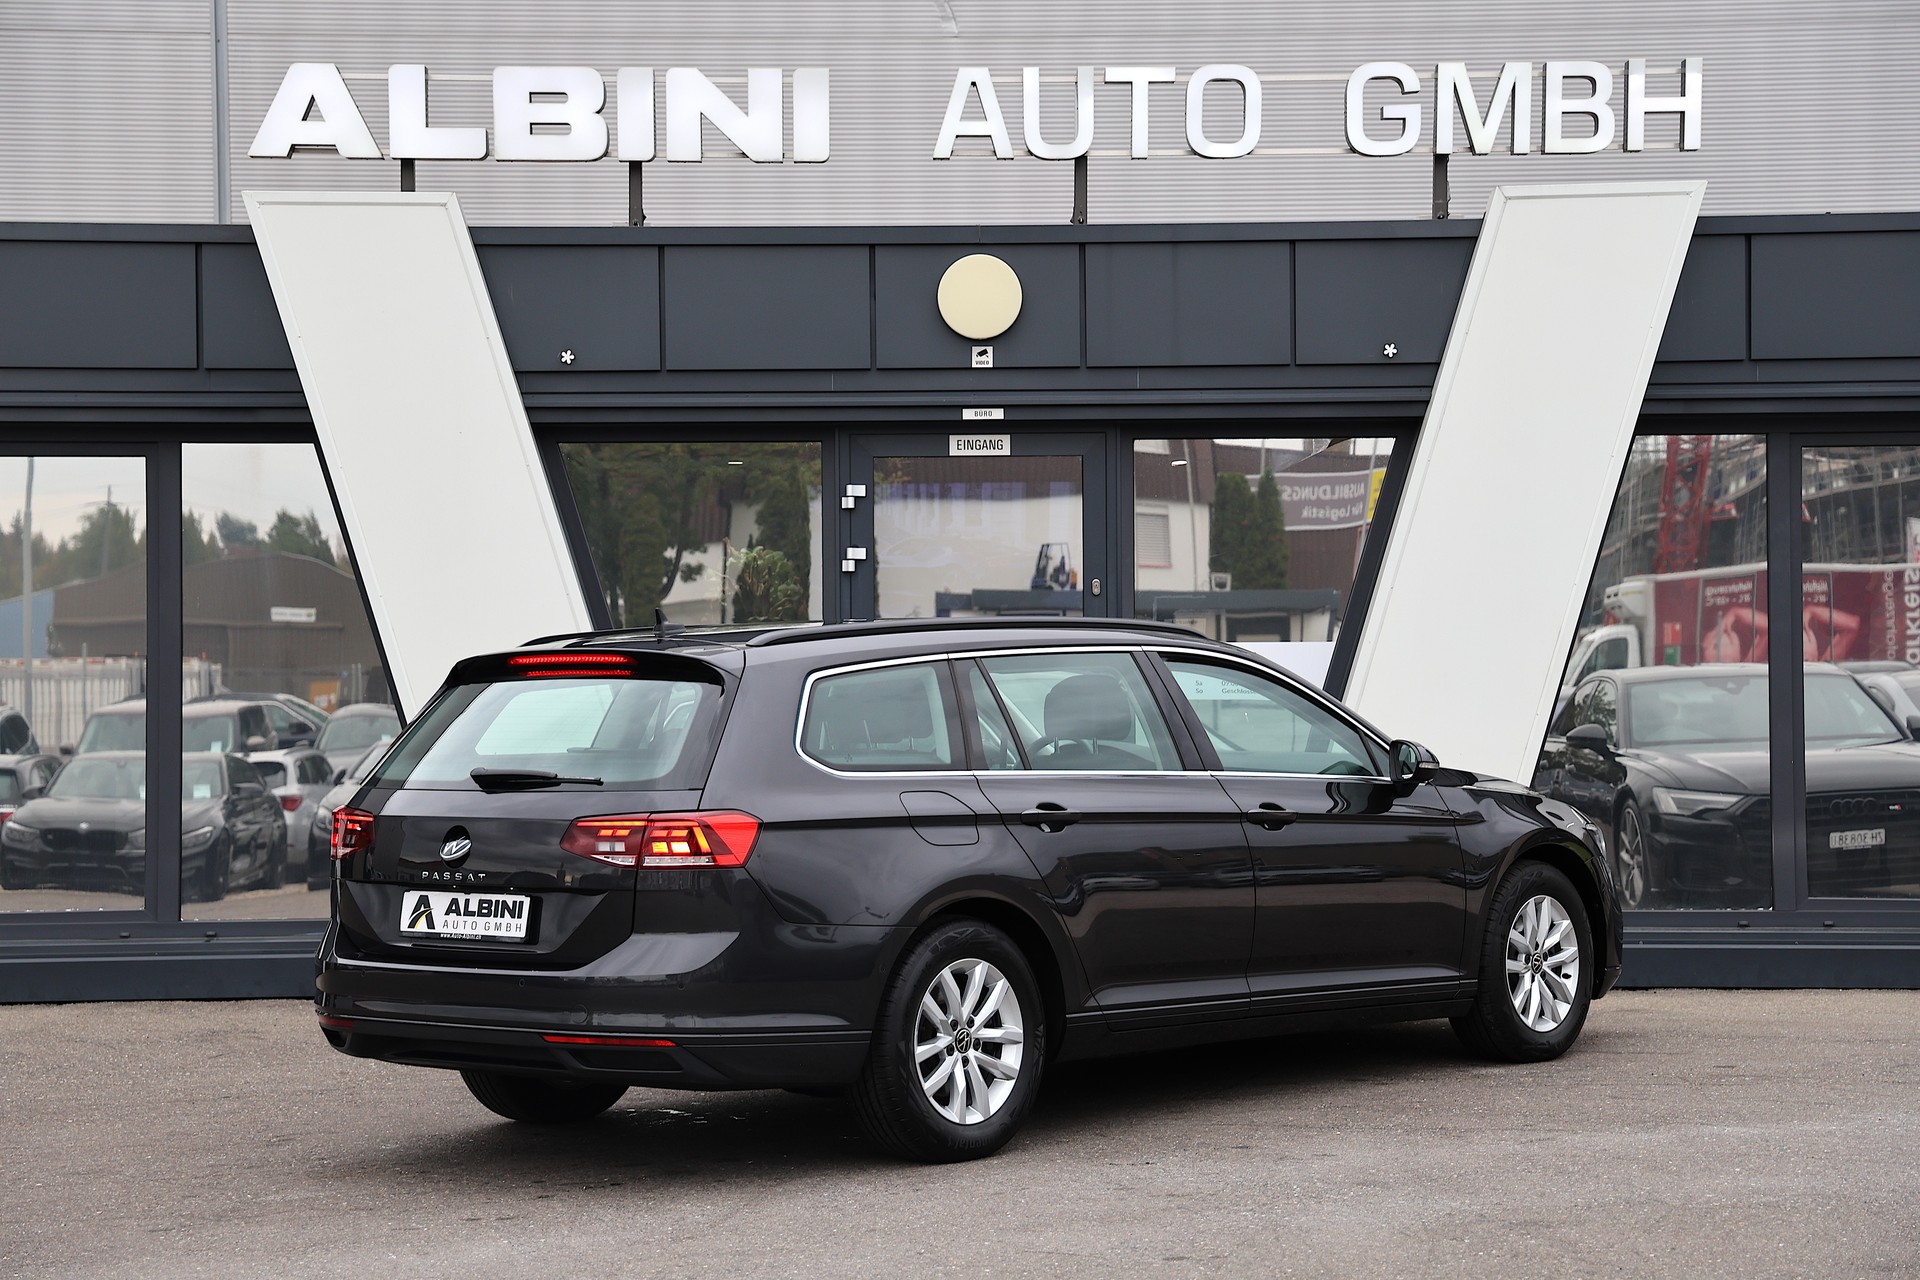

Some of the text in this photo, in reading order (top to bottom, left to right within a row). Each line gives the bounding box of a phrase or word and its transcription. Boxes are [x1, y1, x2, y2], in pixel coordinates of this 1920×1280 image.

[247, 57, 1704, 164] ALBINI AUTO GMBH
[956, 439, 1004, 451] EINGANG
[421, 871, 486, 881] PASSAT
[444, 897, 525, 919] ALBINI
[442, 919, 523, 933] AUTO GMBH
